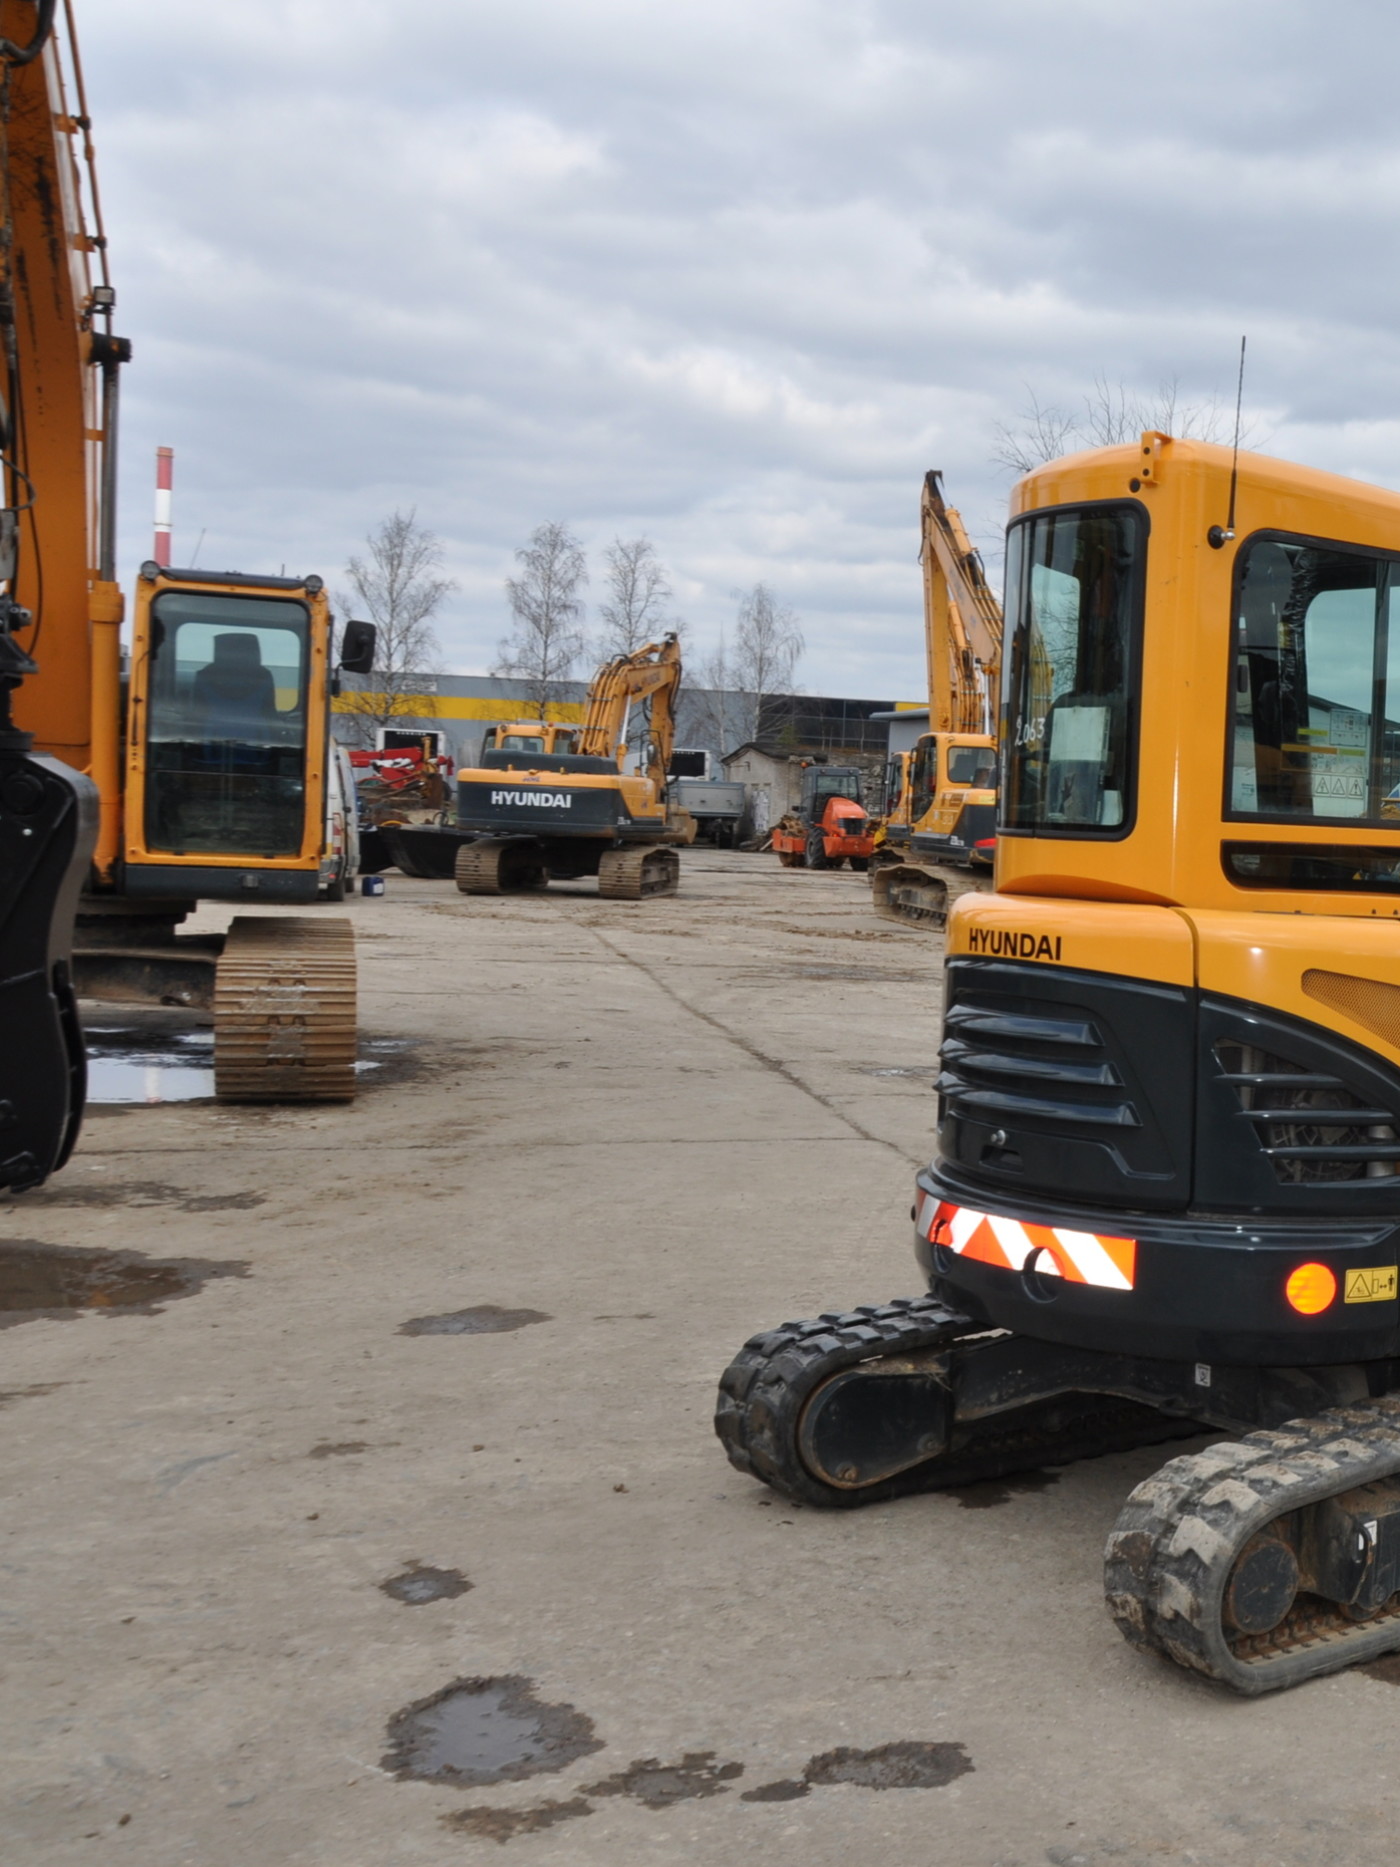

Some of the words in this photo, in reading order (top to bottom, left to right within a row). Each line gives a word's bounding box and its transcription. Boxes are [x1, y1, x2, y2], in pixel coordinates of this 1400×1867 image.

[1014, 714, 1046, 747] 2063
[490, 790, 572, 809] HYUNDAI
[968, 927, 1062, 961] HYUNDAI
